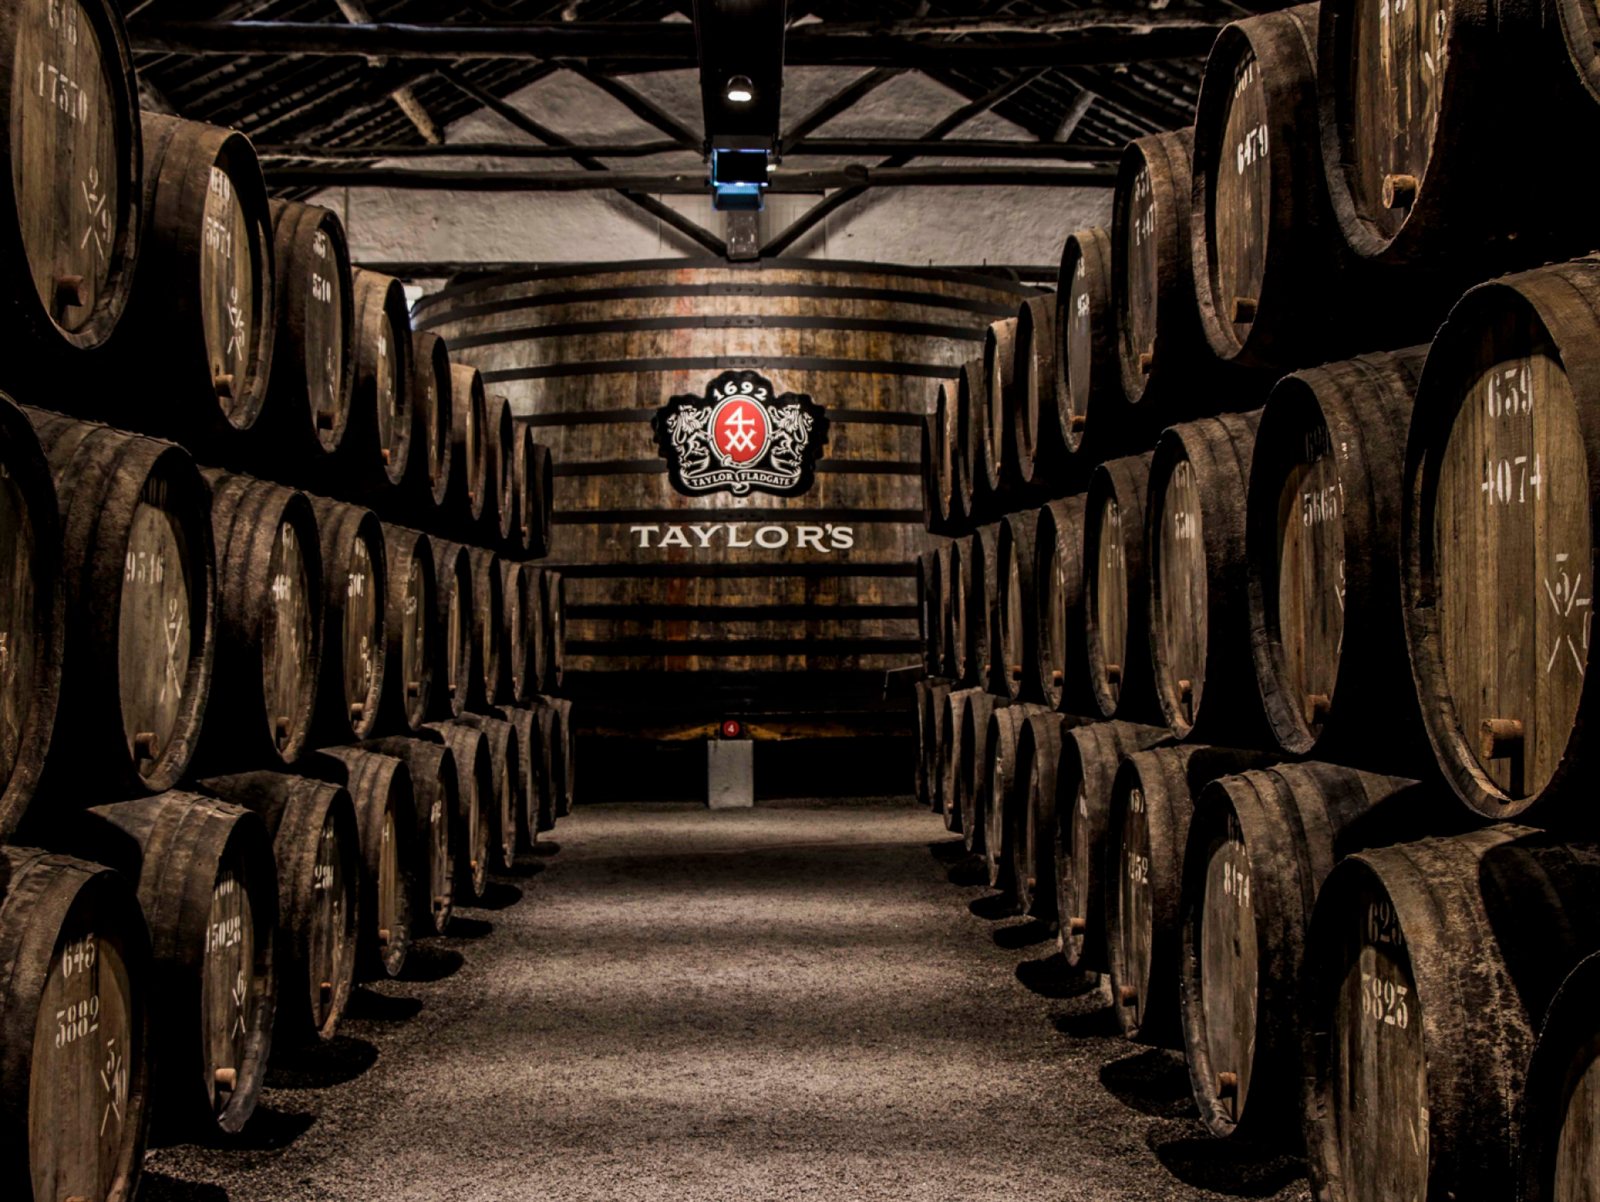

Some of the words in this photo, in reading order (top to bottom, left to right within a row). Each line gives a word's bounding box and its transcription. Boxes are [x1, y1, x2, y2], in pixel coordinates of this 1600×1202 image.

[712, 380, 767, 402] 1692
[691, 473, 733, 487] TAYLOR
[740, 472, 791, 487] FLADGATE
[629, 524, 855, 553] TAYLOR'S
